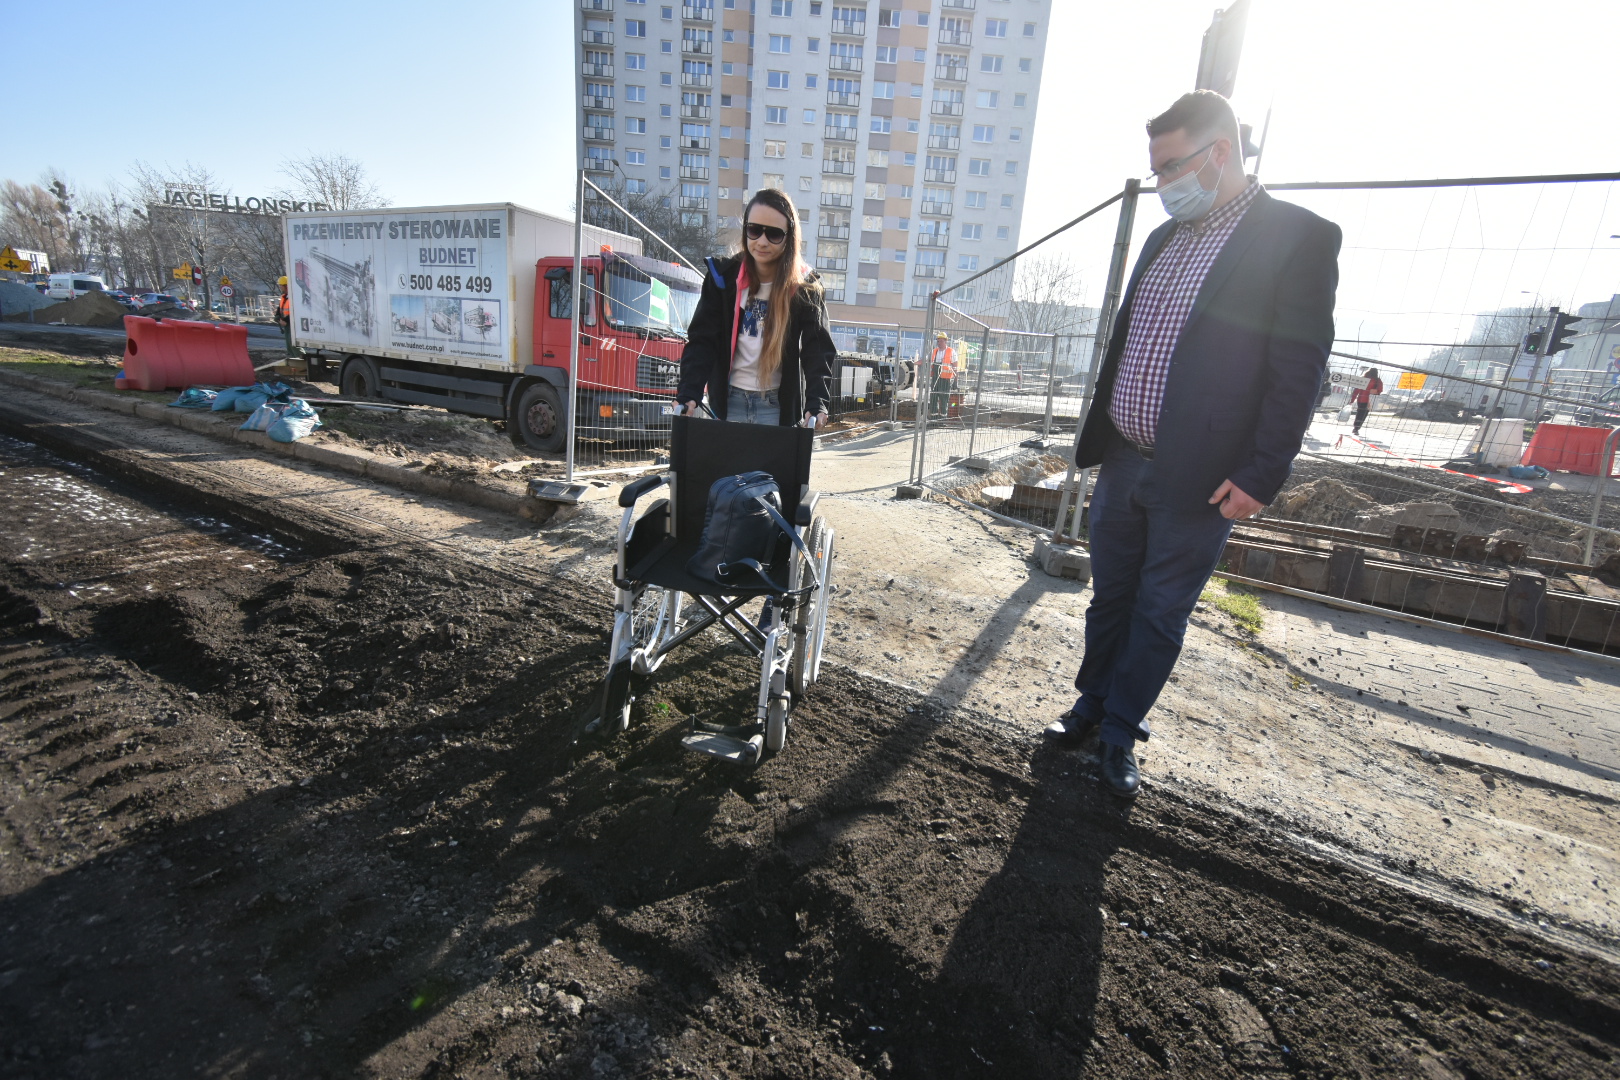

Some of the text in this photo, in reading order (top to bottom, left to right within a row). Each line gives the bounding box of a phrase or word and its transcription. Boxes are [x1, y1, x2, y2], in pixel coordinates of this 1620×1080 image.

[293, 218, 501, 241] PRZEWIERTY STEROWANE
[419, 247, 477, 265] BUDNET
[221, 287, 232, 295] 40
[410, 274, 492, 294] 500 485 499
[391, 341, 445, 353] www.budnet.com.pl
